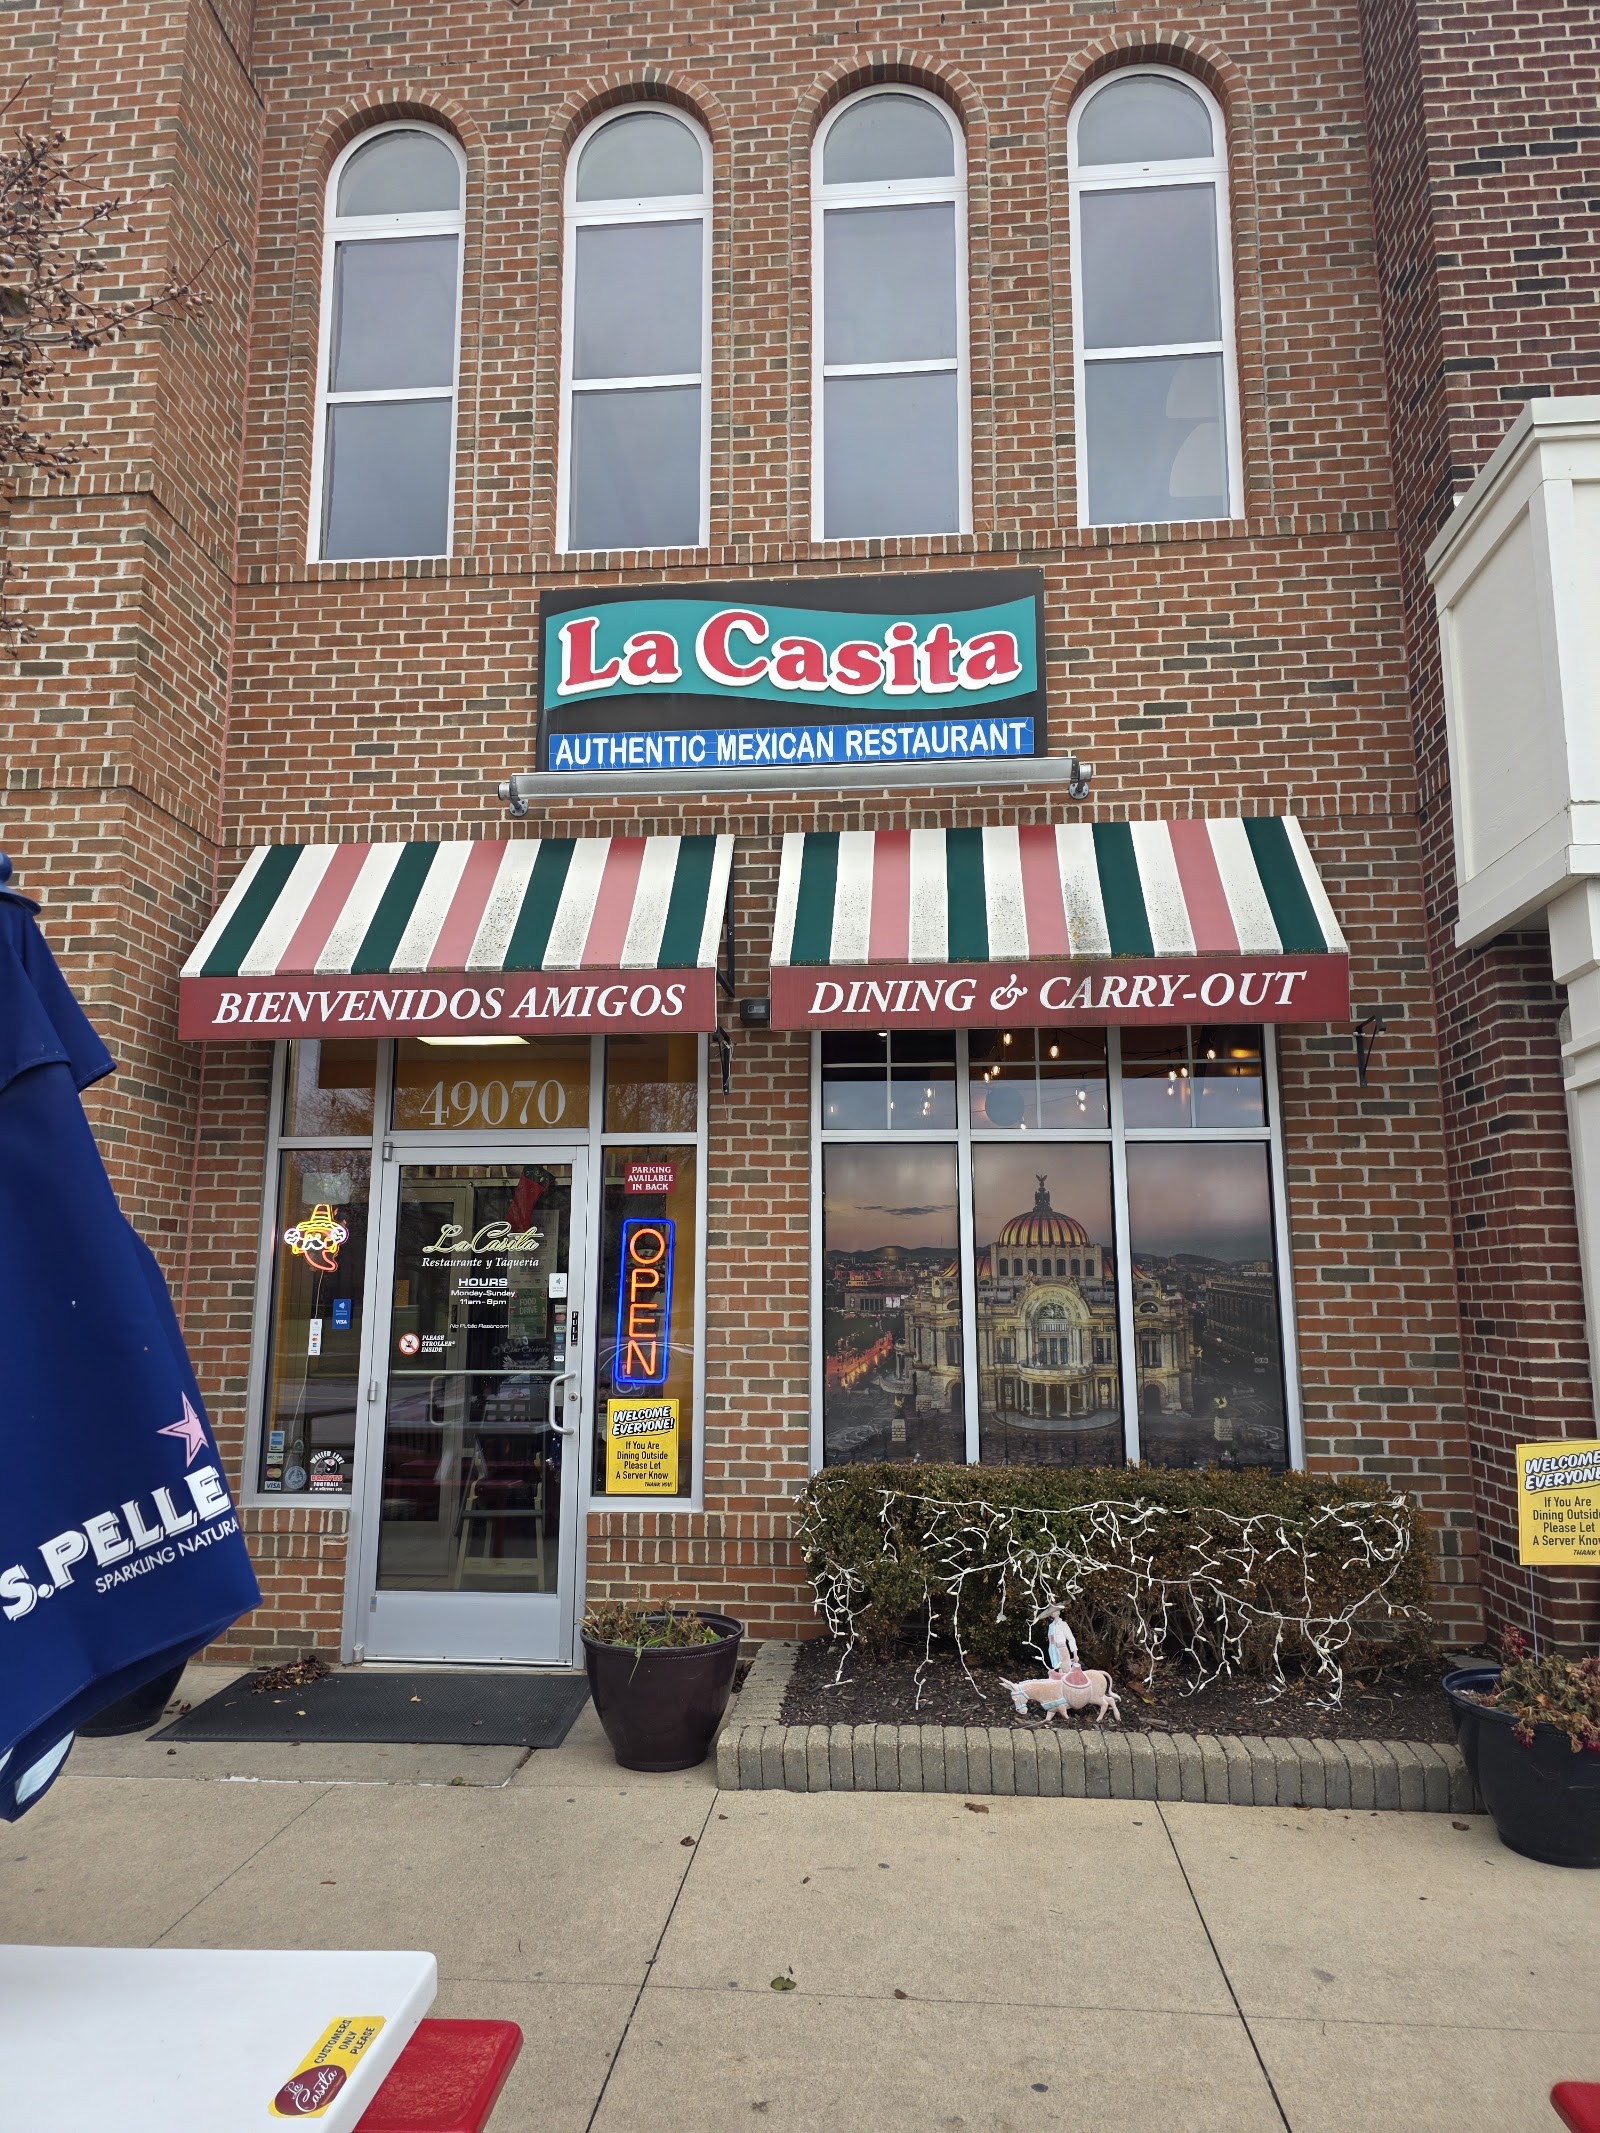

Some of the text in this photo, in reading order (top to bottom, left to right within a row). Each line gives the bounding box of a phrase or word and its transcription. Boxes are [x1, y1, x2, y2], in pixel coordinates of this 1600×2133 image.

[556, 608, 1022, 697] La Casita
[555, 722, 1026, 766] AUTHENTIC MEXICAN RESTAURANT
[808, 970, 1308, 1014] DINING & CARRY-OUT
[211, 984, 686, 1024] BIENVENIDOS AMIGOS
[419, 1079, 566, 1127] 49070
[627, 1174, 674, 1182] AVAILABLE
[631, 1166, 671, 1174] PARKING
[632, 1183, 669, 1191] IN BACK
[422, 1221, 544, 1253] La Casita
[422, 1257, 482, 1267] Restaurante
[485, 1259, 493, 1269] y
[458, 1278, 508, 1287] HOURS
[450, 1289, 516, 1298] Monday-Sunday
[520, 1297, 537, 1307] FOOD
[626, 1228, 666, 1375] OPEN
[612, 1406, 672, 1423] WELCOME
[612, 1417, 675, 1437] EVERYONE!
[625, 1441, 660, 1450] If You Are
[617, 1451, 669, 1461] Dining Outside
[1525, 1449, 1600, 1474] WELCOME
[624, 1461, 661, 1470] Please Let
[615, 1471, 669, 1480] A Server Know
[1544, 1496, 1592, 1507] If You Are
[1533, 1509, 1563, 1522] Dining
[1543, 1521, 1596, 1533] Please Let
[0, 1465, 231, 1622] S.PELLE
[1532, 1535, 1539, 1545] A
[1542, 1534, 1576, 1545] Server
[95, 1546, 175, 1593] SPARKLING
[313, 2019, 352, 2064] CUSTOMERS
[338, 2030, 357, 2050] ONLY
[349, 2026, 375, 2054] PLEASE
[284, 2067, 338, 2112] La Casita
